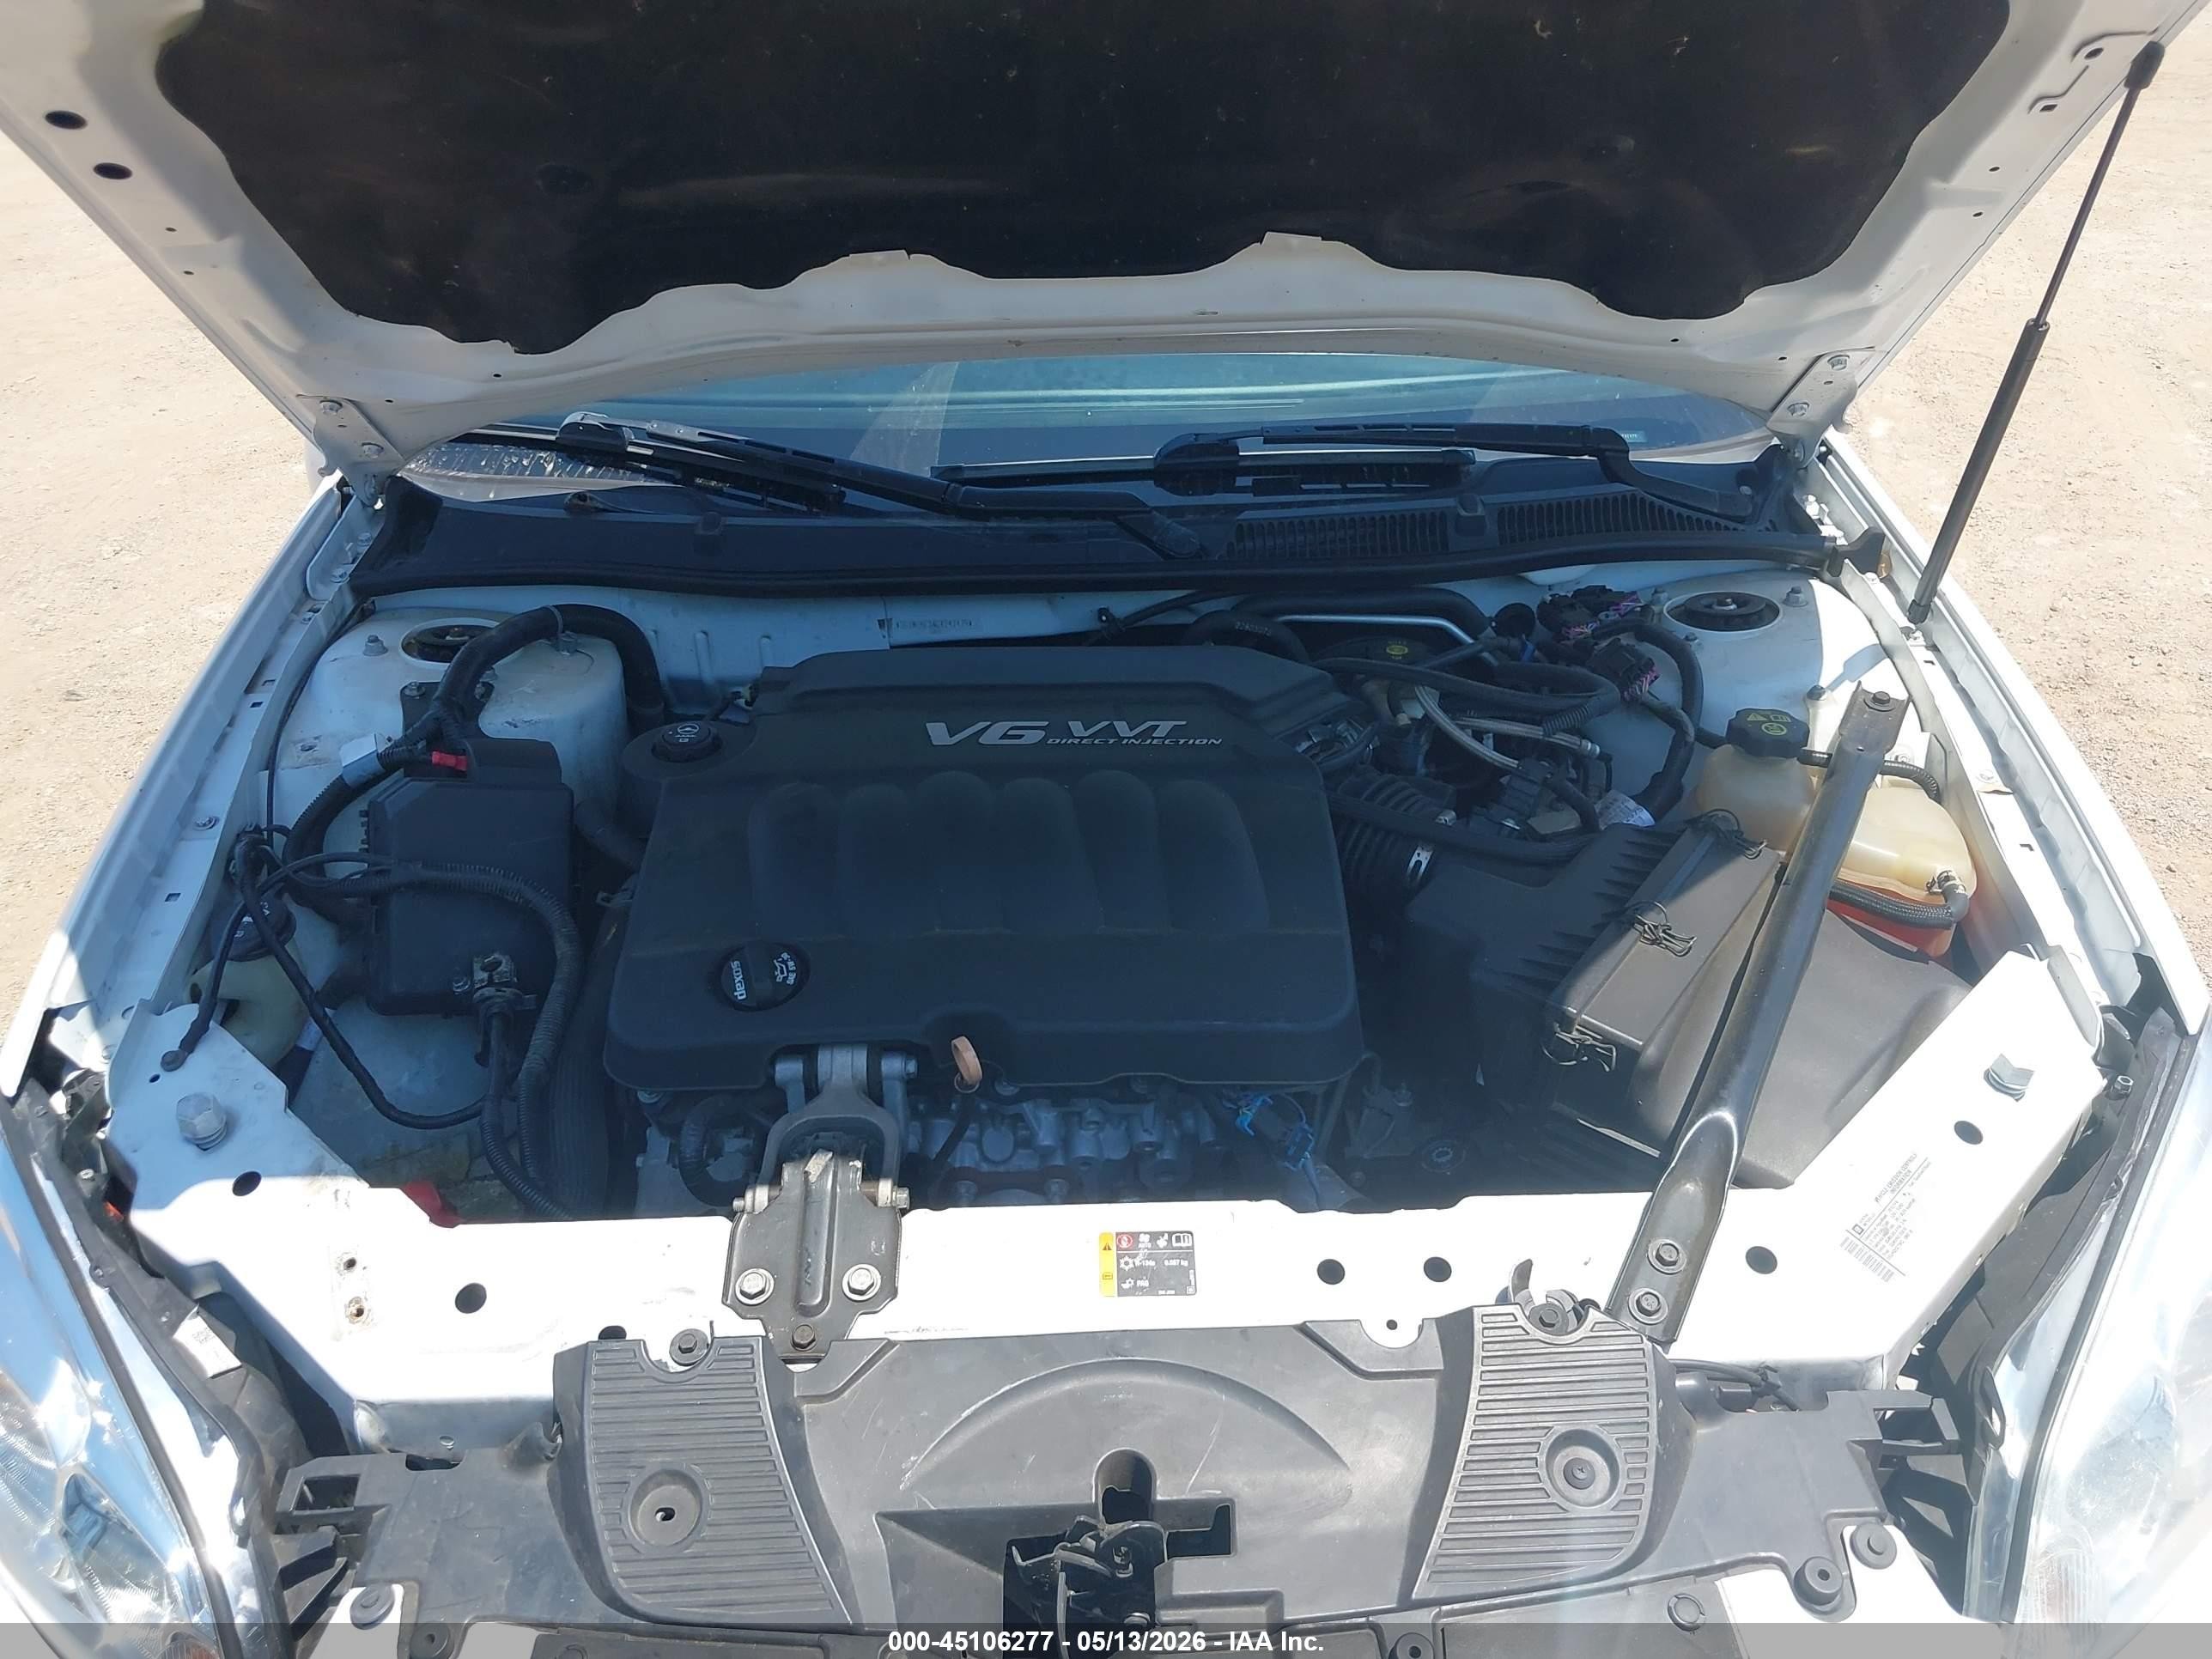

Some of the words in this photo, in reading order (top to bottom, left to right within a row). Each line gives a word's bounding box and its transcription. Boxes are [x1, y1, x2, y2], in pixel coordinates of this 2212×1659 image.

[926, 721, 1049, 745] V6
[1068, 720, 1187, 738] VVT
[730, 960, 747, 1000] dexos
